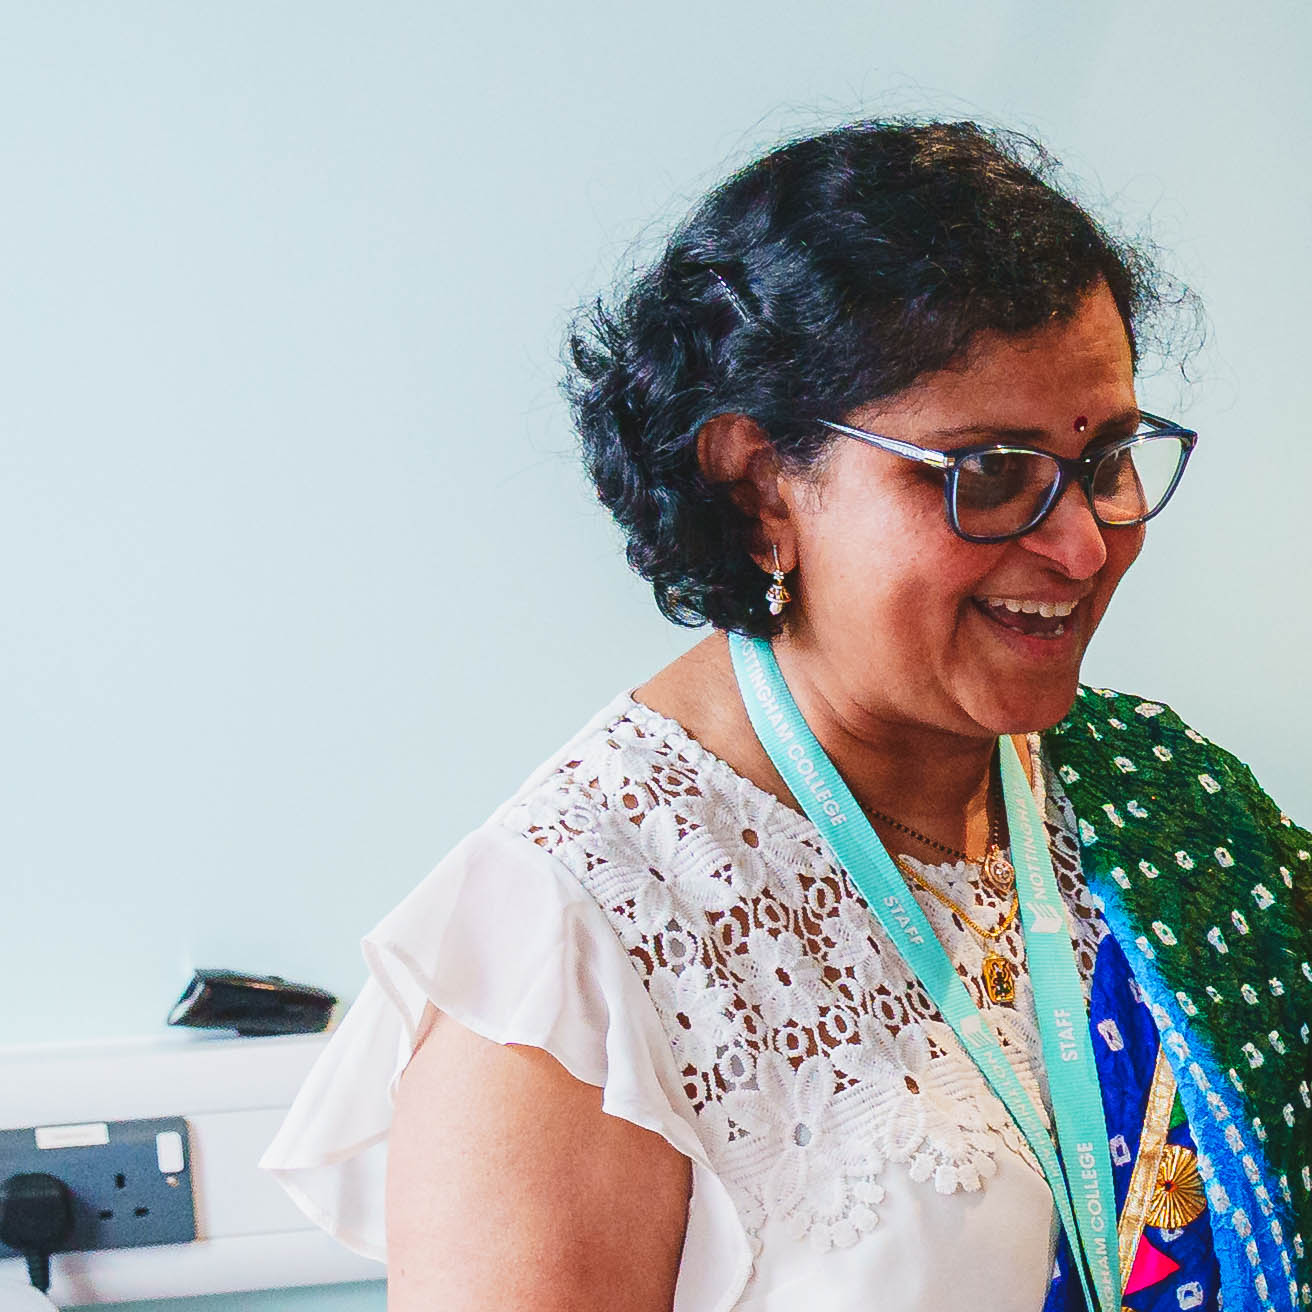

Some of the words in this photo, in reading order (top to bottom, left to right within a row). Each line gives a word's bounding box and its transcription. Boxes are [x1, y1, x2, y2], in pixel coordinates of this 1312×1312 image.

[787, 743, 848, 827] COLLEGE
[883, 895, 924, 945] STAFF
[1054, 1008, 1079, 1062] STAFF
[1076, 1141, 1105, 1233] COLLEGE
